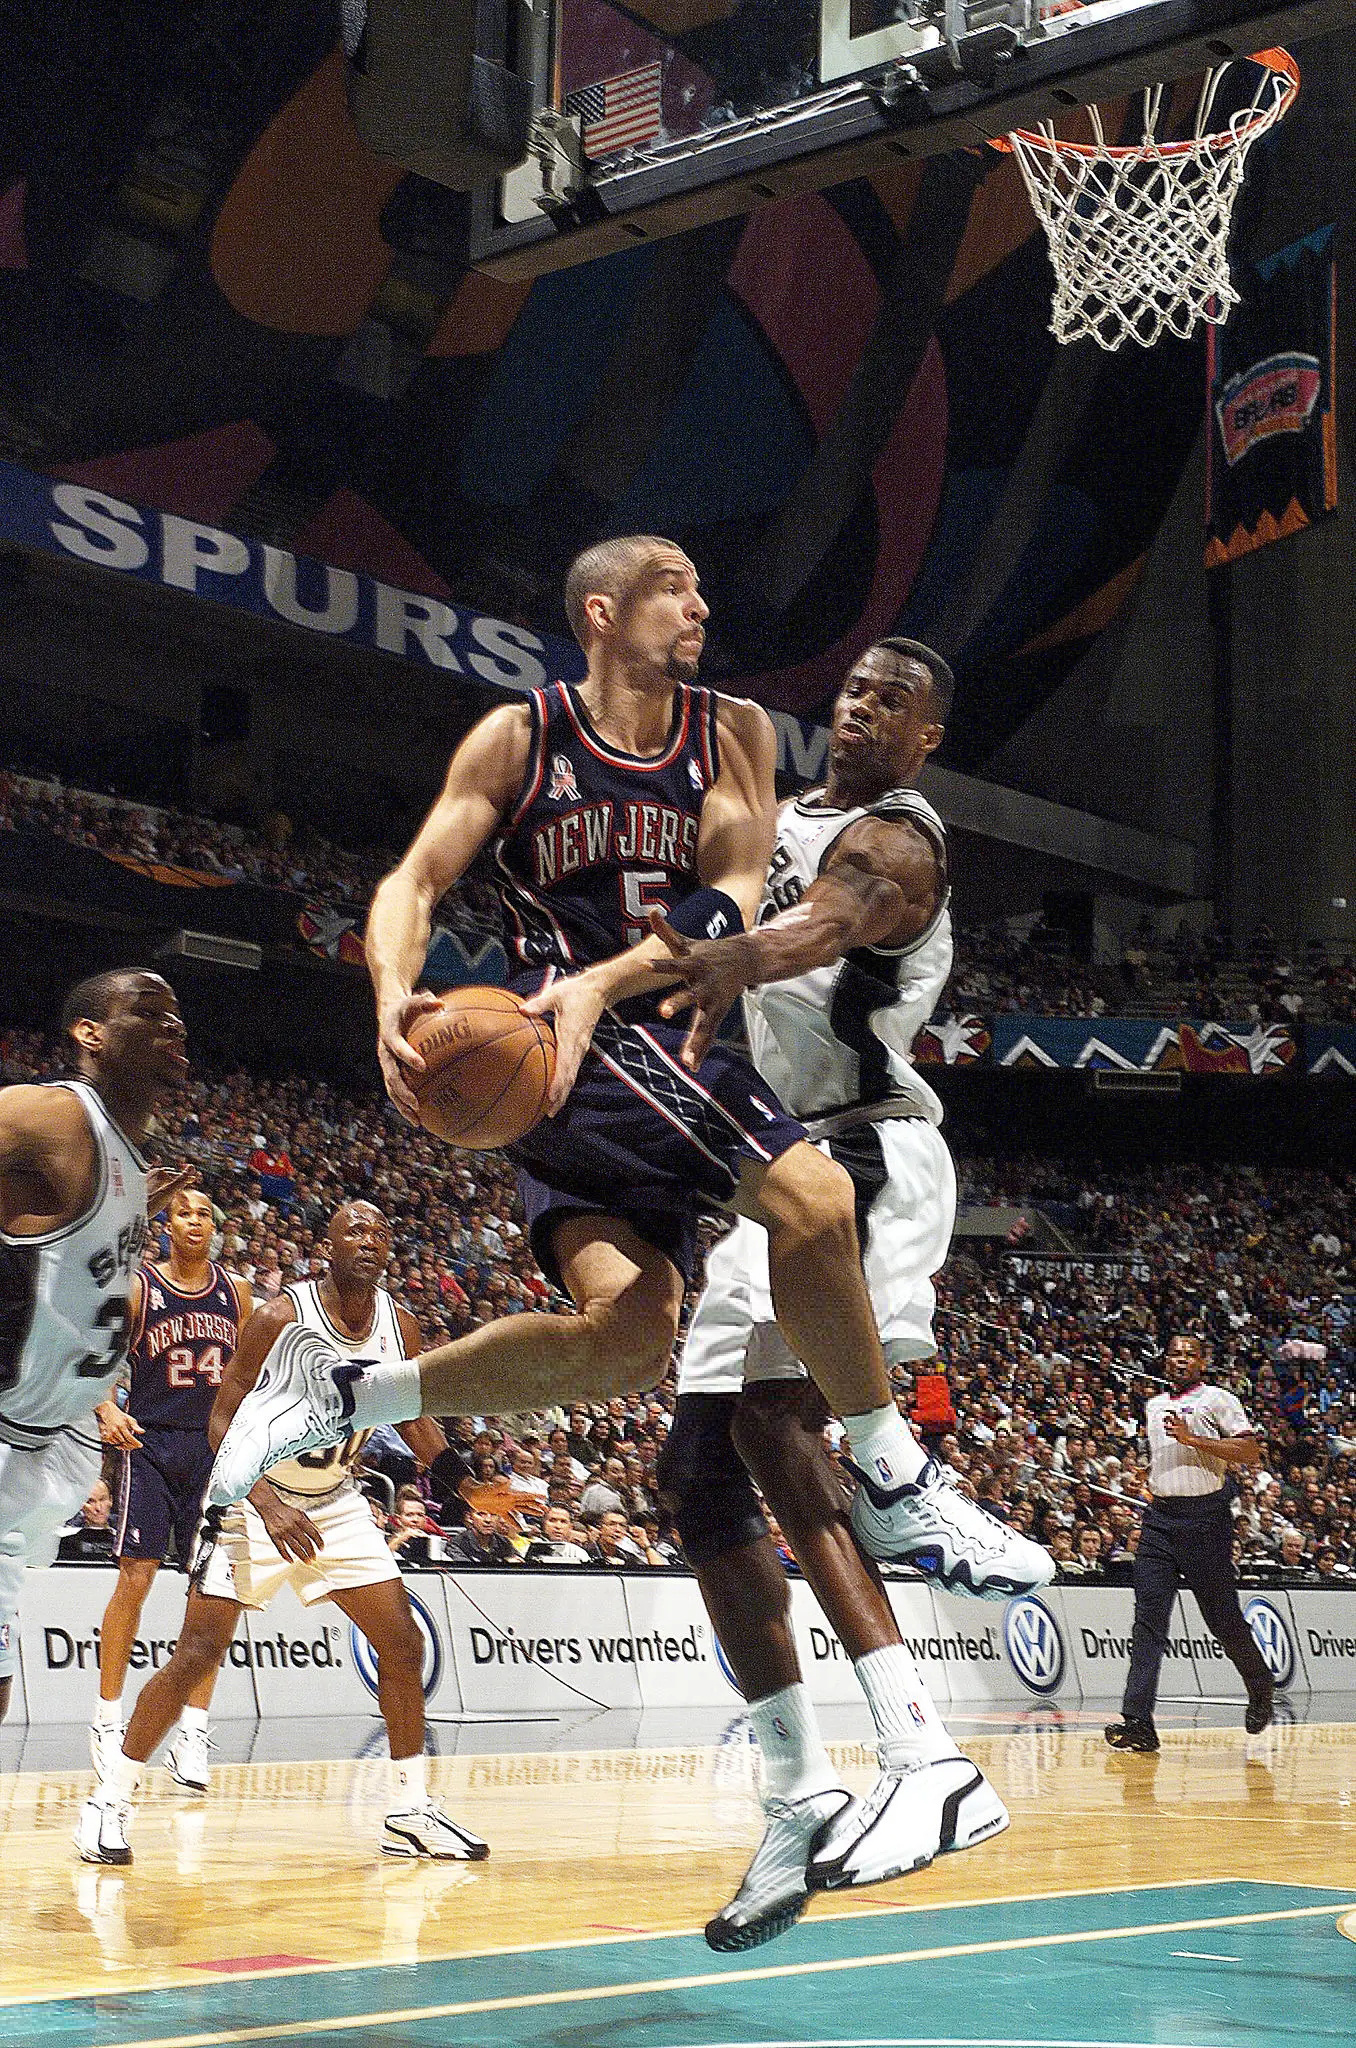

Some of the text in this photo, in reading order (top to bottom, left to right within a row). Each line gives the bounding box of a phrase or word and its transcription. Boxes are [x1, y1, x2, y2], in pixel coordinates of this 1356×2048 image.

[51, 483, 547, 691] SPURS
[532, 800, 700, 889] NEW JERS
[417, 1016, 473, 1054] DING
[147, 1315, 184, 1359] NEW
[168, 1345, 224, 1388] 24
[44, 1625, 343, 1669] Drier anted.
[470, 1624, 707, 1664] Drivers wanted.
[904, 1626, 1000, 1661] wanted.
[1080, 1628, 1224, 1659] Drive wante
[1306, 1629, 1356, 1657] Drive
